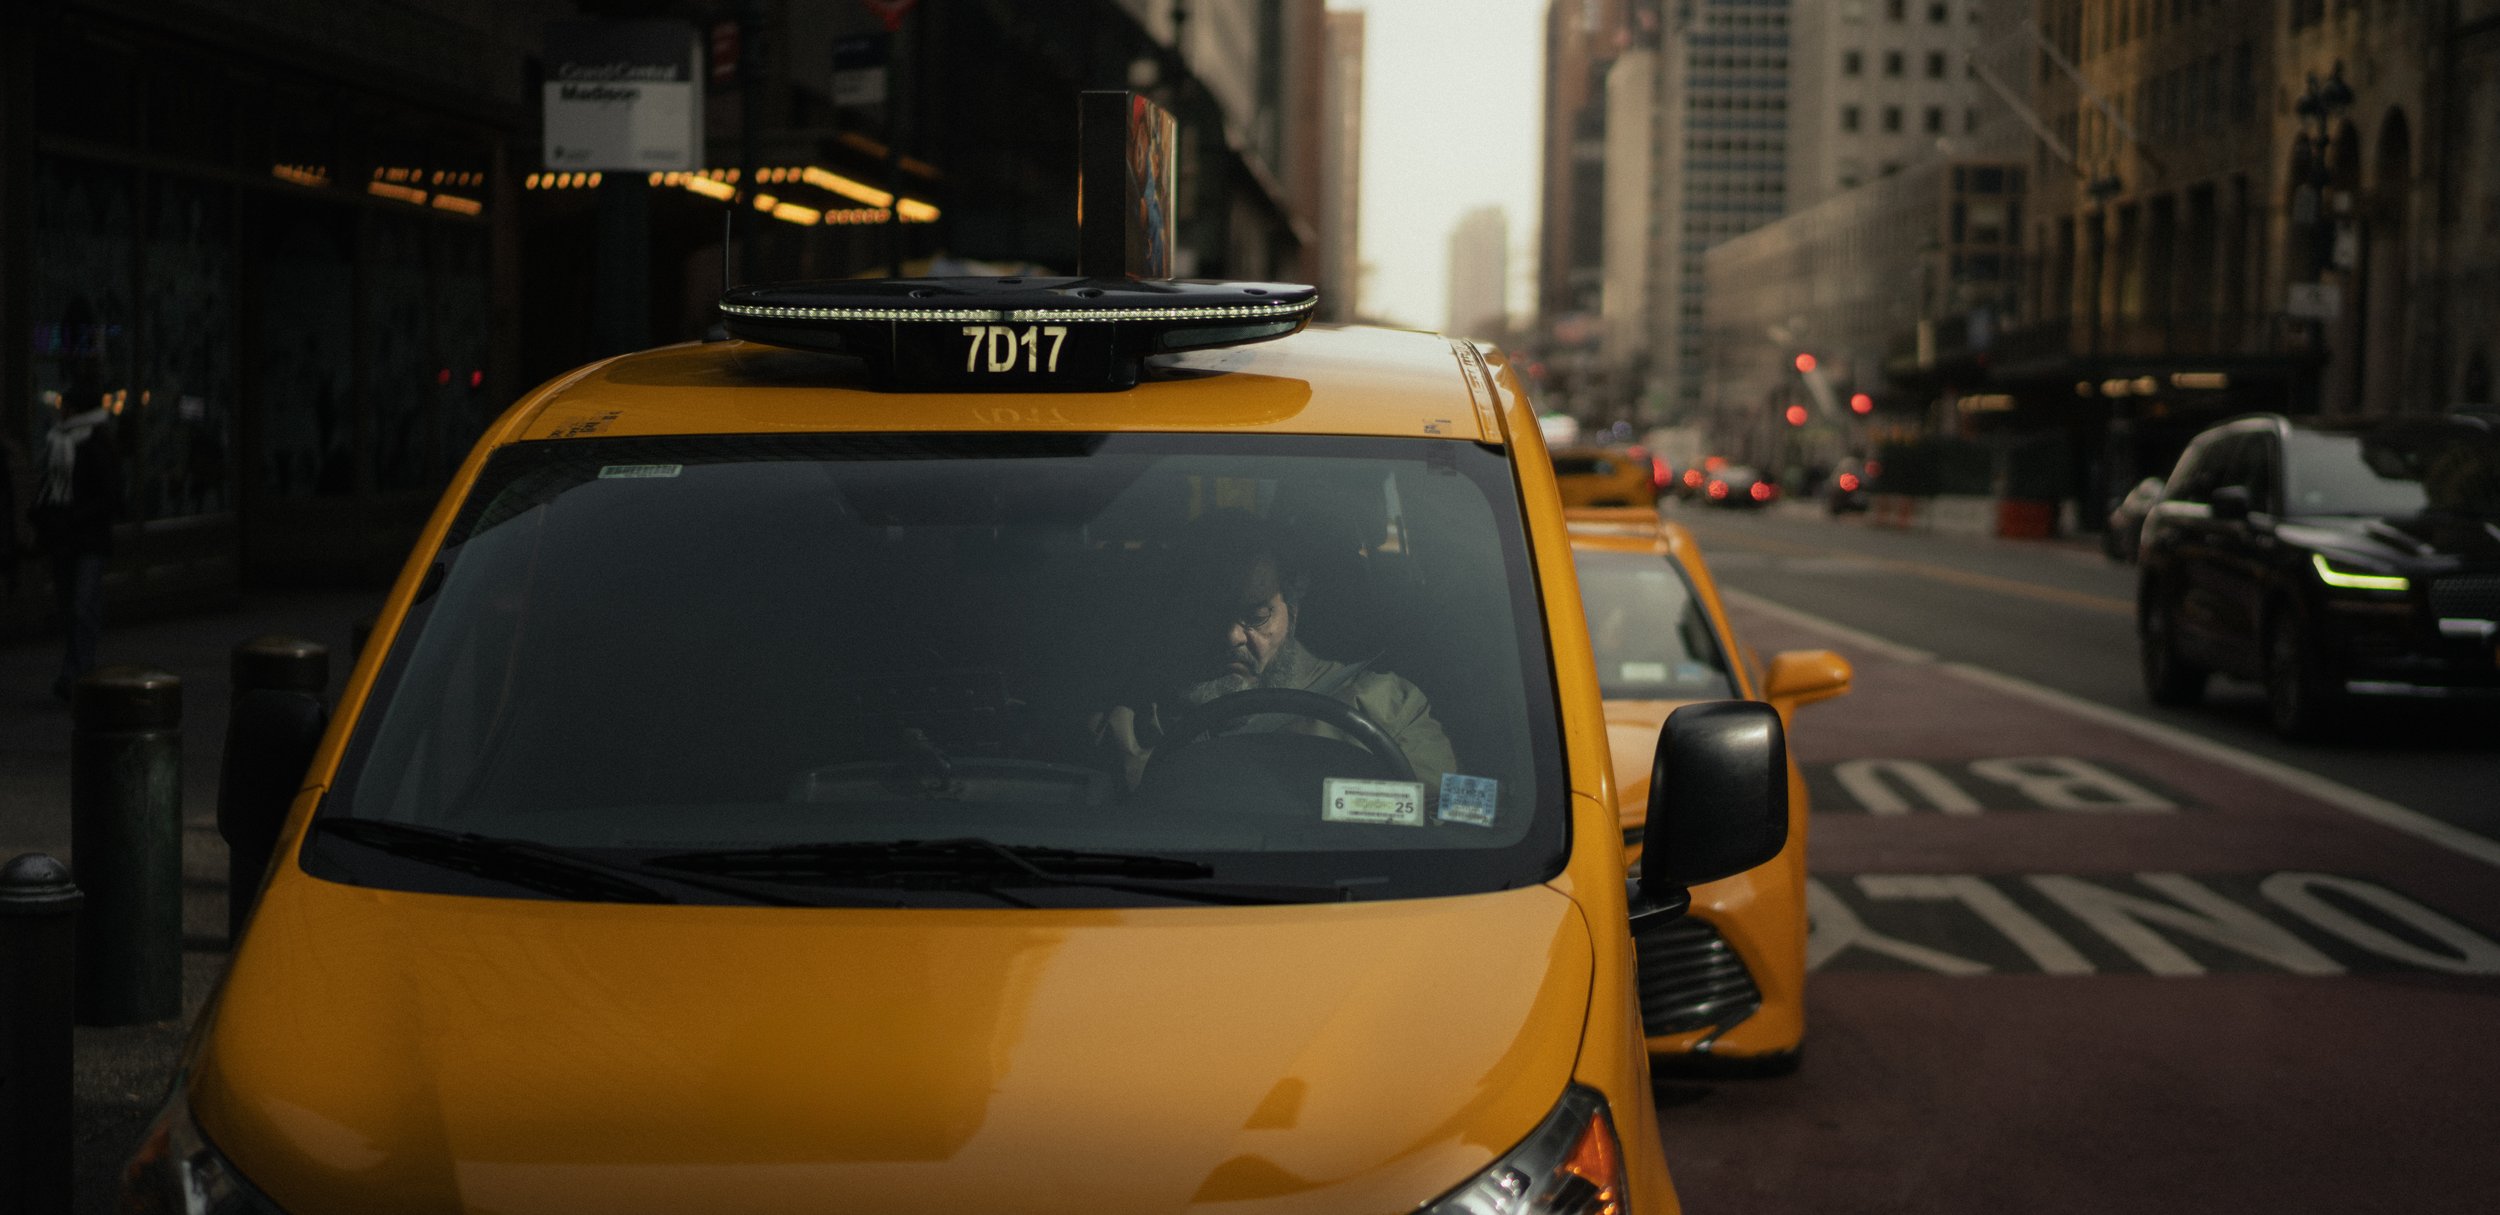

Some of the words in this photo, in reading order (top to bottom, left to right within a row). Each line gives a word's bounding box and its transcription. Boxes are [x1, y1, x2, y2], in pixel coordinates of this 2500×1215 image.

[615, 63, 679, 81] Central
[561, 84, 638, 99] Madison
[962, 325, 1069, 373] 7D17
[1833, 757, 2182, 814] BU
[1334, 798, 1344, 810] 6
[1394, 802, 1414, 814] 25
[1805, 870, 2500, 976] ONLY
